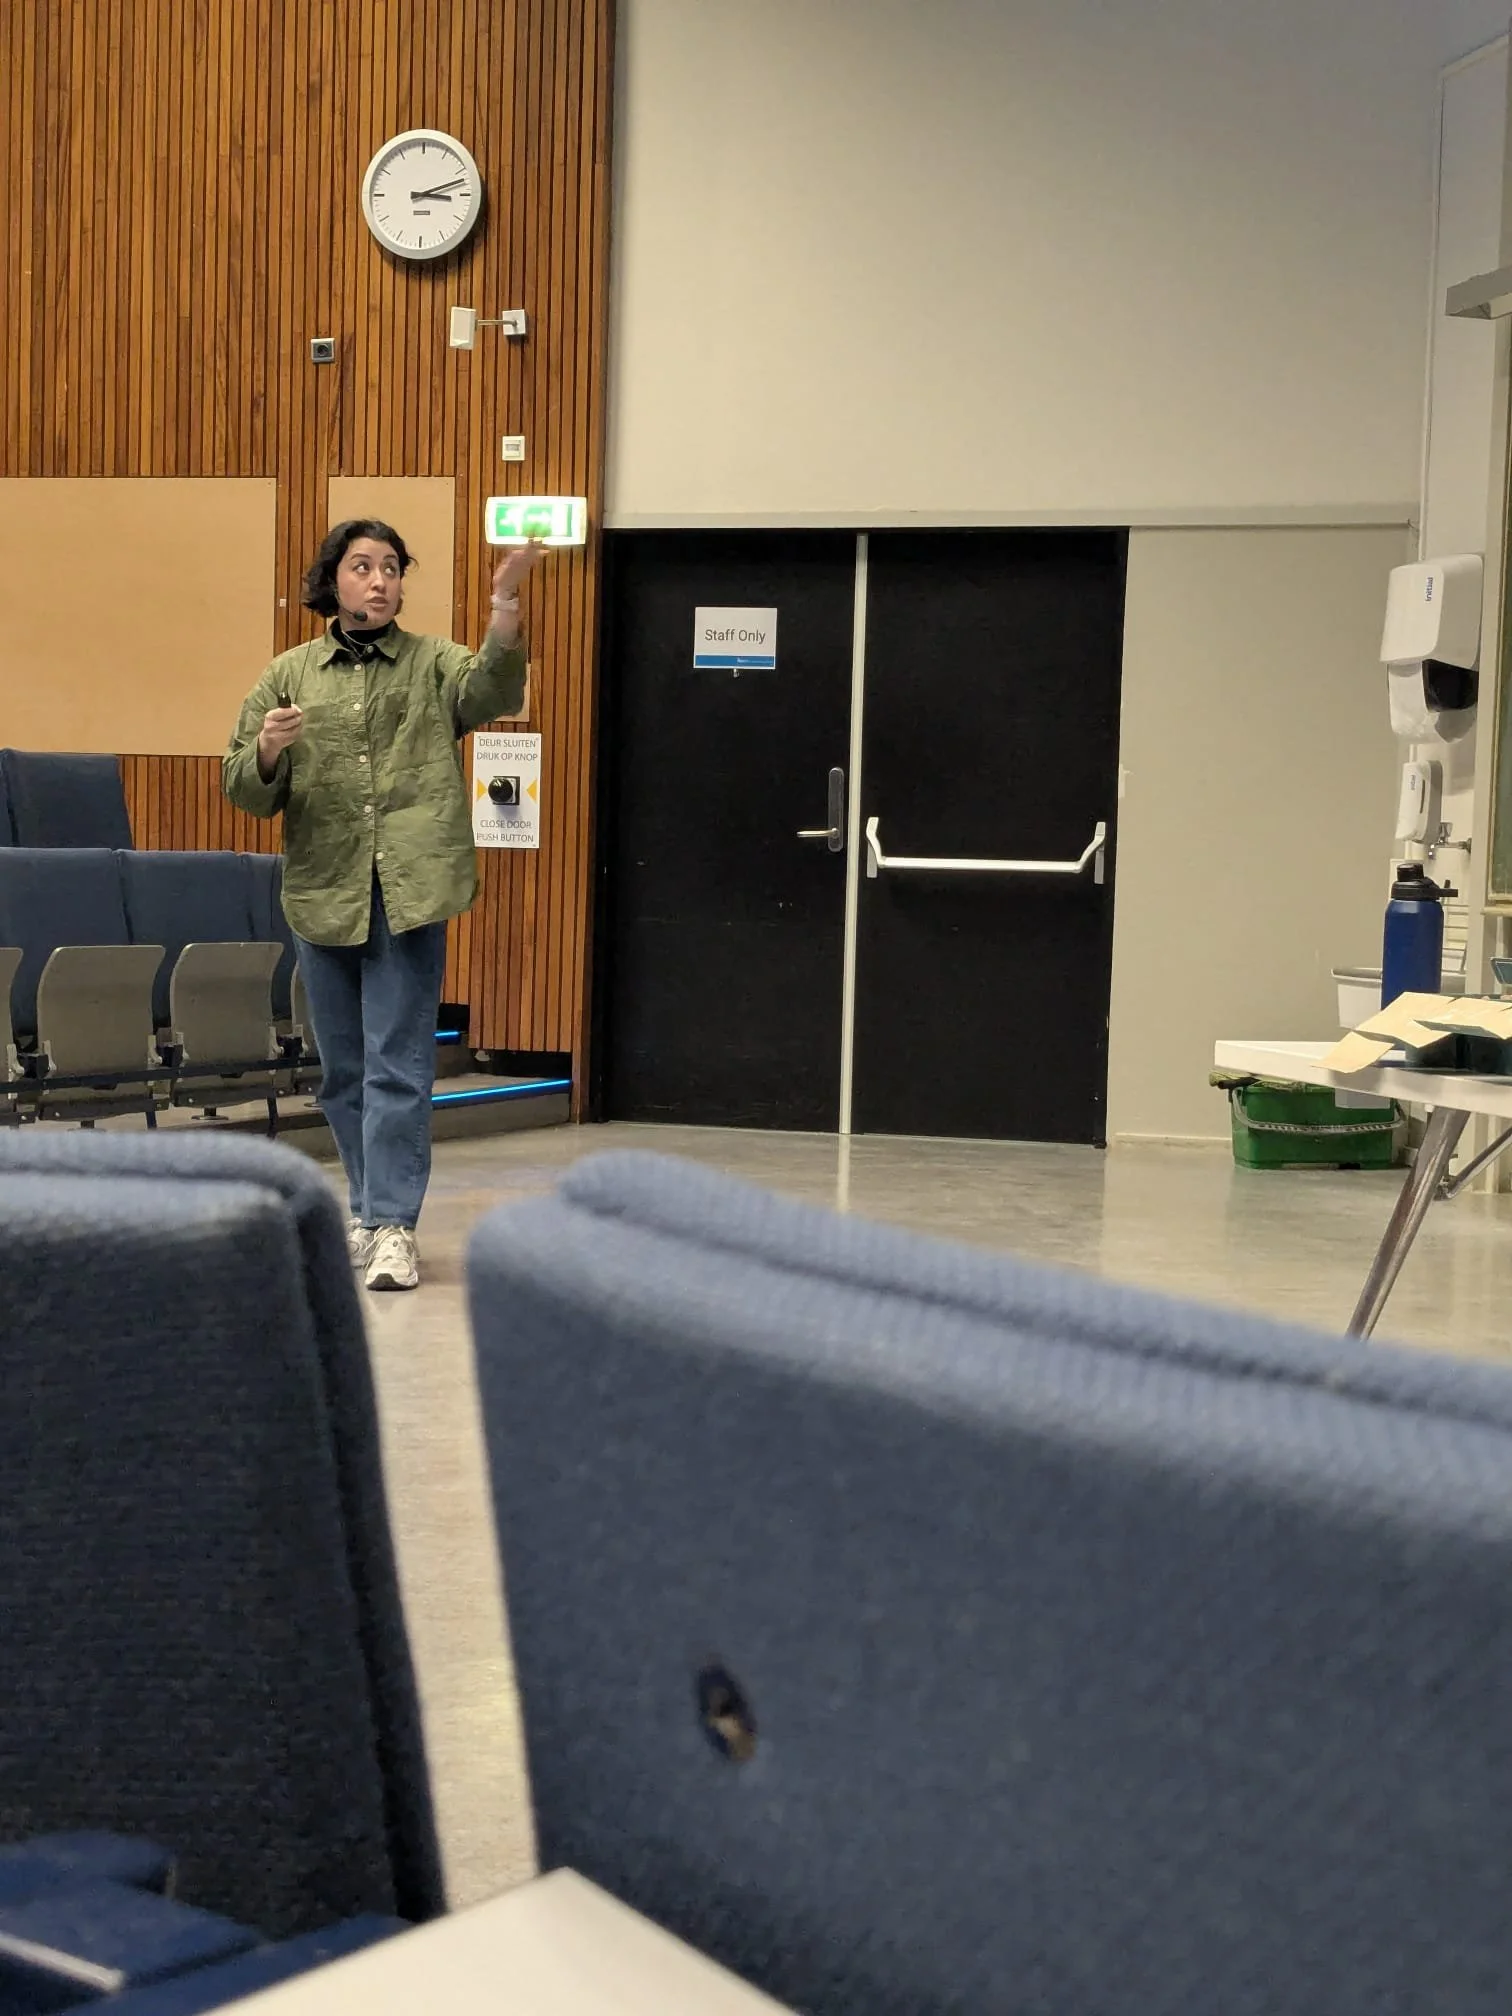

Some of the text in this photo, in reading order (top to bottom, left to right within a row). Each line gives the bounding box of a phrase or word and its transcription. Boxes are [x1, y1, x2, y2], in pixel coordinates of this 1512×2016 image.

[704, 628, 766, 645] Staff Only
[479, 738, 536, 748] DEUR SLUITEN
[476, 752, 538, 762] DRUK OP KNOP
[480, 819, 532, 829] CLOSE DOOR
[476, 832, 534, 843] PUSH BUTTON
